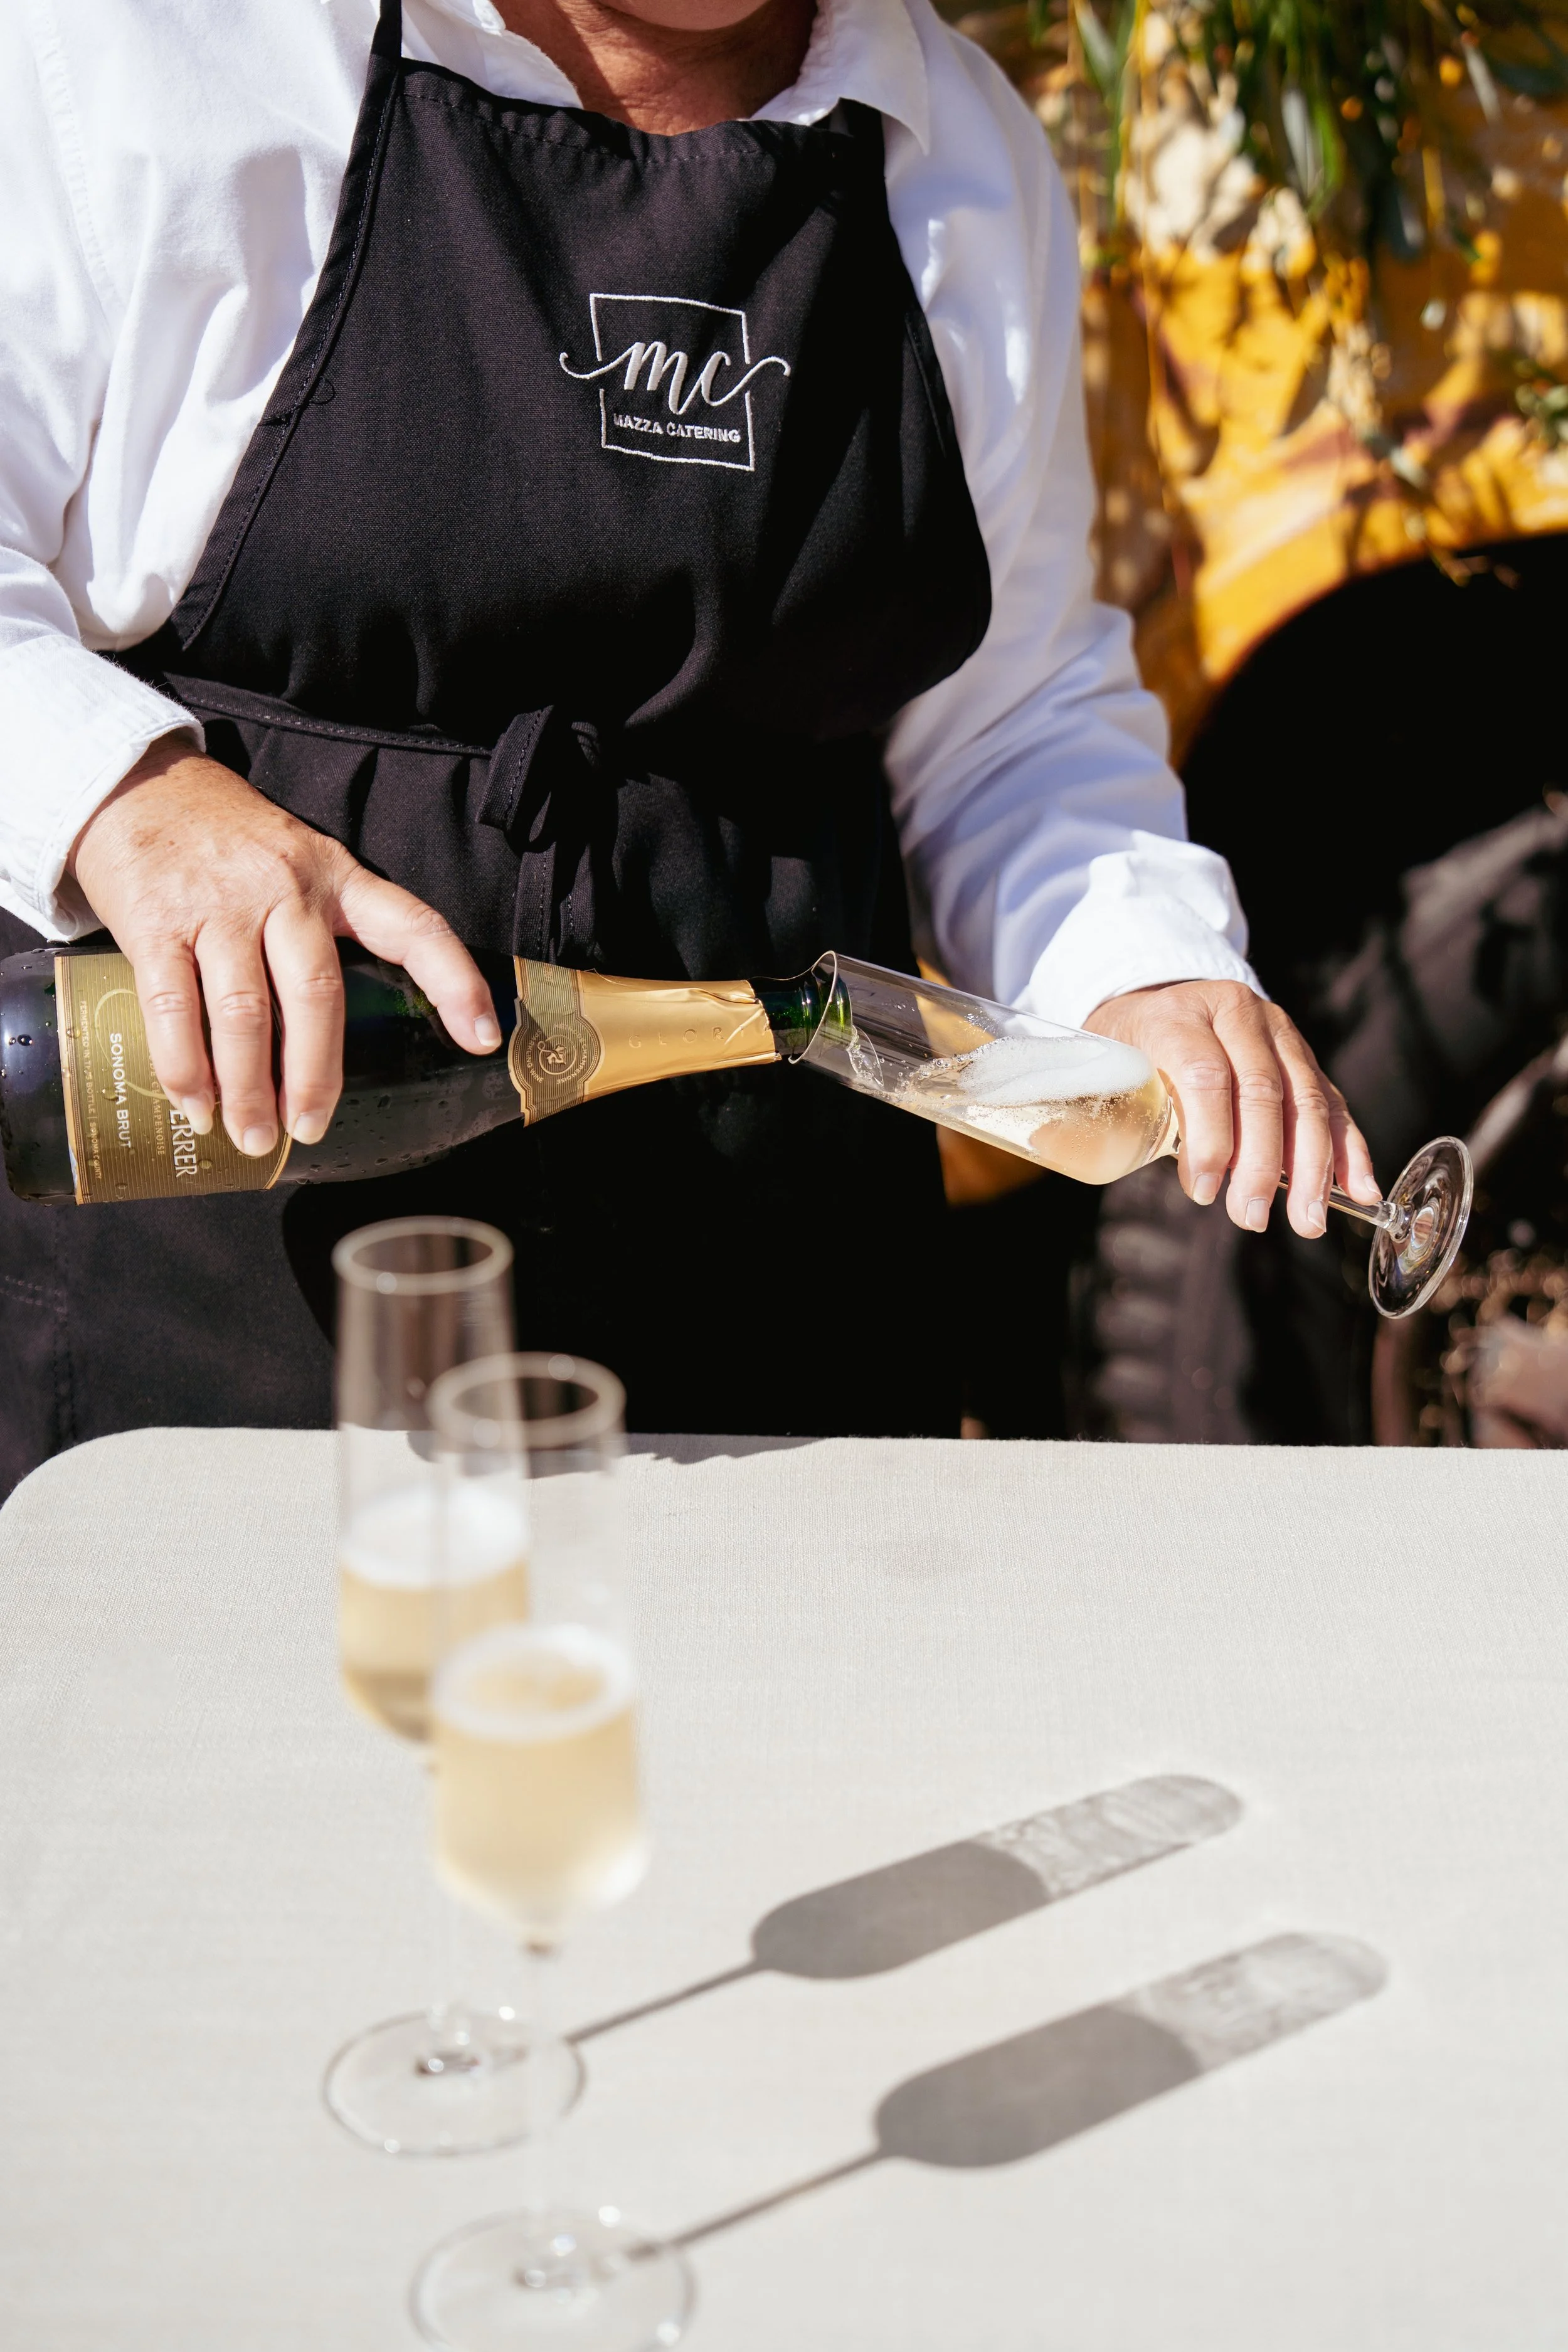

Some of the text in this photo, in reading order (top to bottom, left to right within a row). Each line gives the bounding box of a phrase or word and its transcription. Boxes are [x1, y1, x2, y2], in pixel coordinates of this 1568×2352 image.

[613, 413, 741, 443] MAZZA CATERING
[80, 1000, 90, 1048] FERMENTED
[83, 1049, 90, 1059] IN
[526, 1029, 544, 1084] SPARKLING WINE
[85, 1082, 95, 1114] BOTTLE
[110, 1033, 131, 1148] SONOMA BRUT
[90, 1122, 100, 1155] SONOMA
[169, 1109, 198, 1178] ERRER
